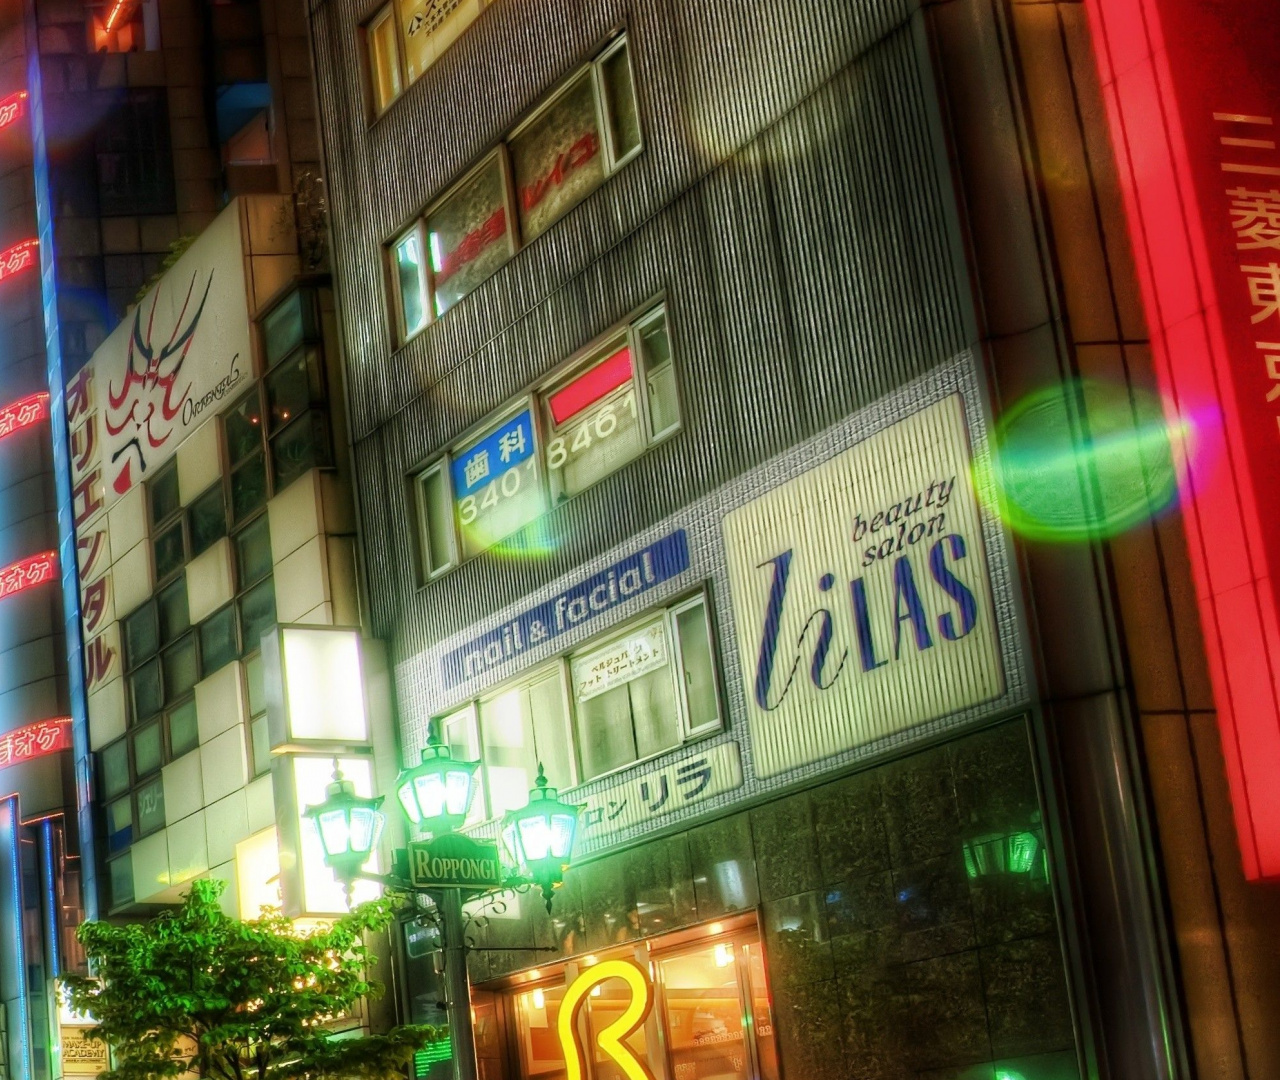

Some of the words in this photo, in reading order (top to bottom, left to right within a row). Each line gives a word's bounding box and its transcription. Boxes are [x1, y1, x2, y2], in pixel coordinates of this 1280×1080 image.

[458, 456, 540, 527] 3401
[546, 397, 638, 471] 8461
[463, 424, 527, 490] 歯科
[66, 364, 116, 688] オリエンタル
[851, 474, 957, 543] beauty
[860, 511, 947, 567] salon
[463, 625, 525, 682] nail
[529, 618, 549, 643] &
[553, 548, 656, 637] facial
[640, 758, 713, 812] リラ
[415, 848, 497, 882] ROPPONGI
[62, 1039, 102, 1050] MAKE-UP
[62, 1049, 106, 1059] ACADEMY
